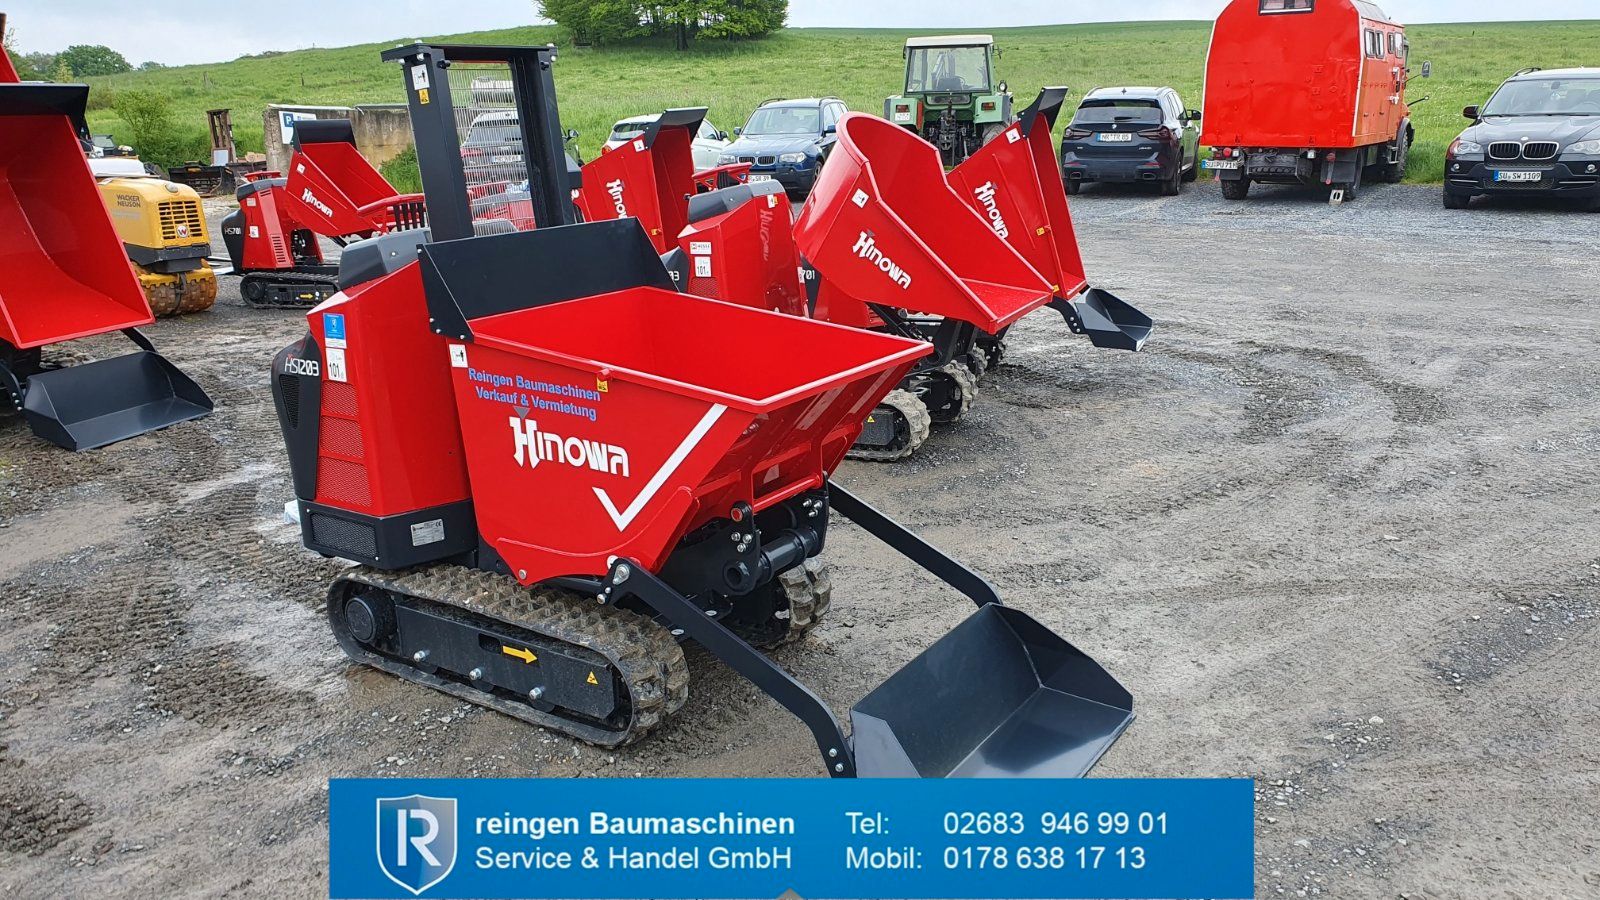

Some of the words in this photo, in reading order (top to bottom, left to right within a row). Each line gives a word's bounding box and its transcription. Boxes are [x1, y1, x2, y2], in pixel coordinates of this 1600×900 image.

[301, 188, 333, 217] Hinowa
[852, 231, 912, 289] Hinowa
[329, 362, 340, 378] 101
[468, 367, 513, 387] Reingen
[515, 375, 601, 402] Baumaschinen
[475, 386, 518, 404] Verkauf
[520, 393, 529, 406] &
[530, 395, 597, 422] Vermietung
[509, 416, 630, 478] Hinowa
